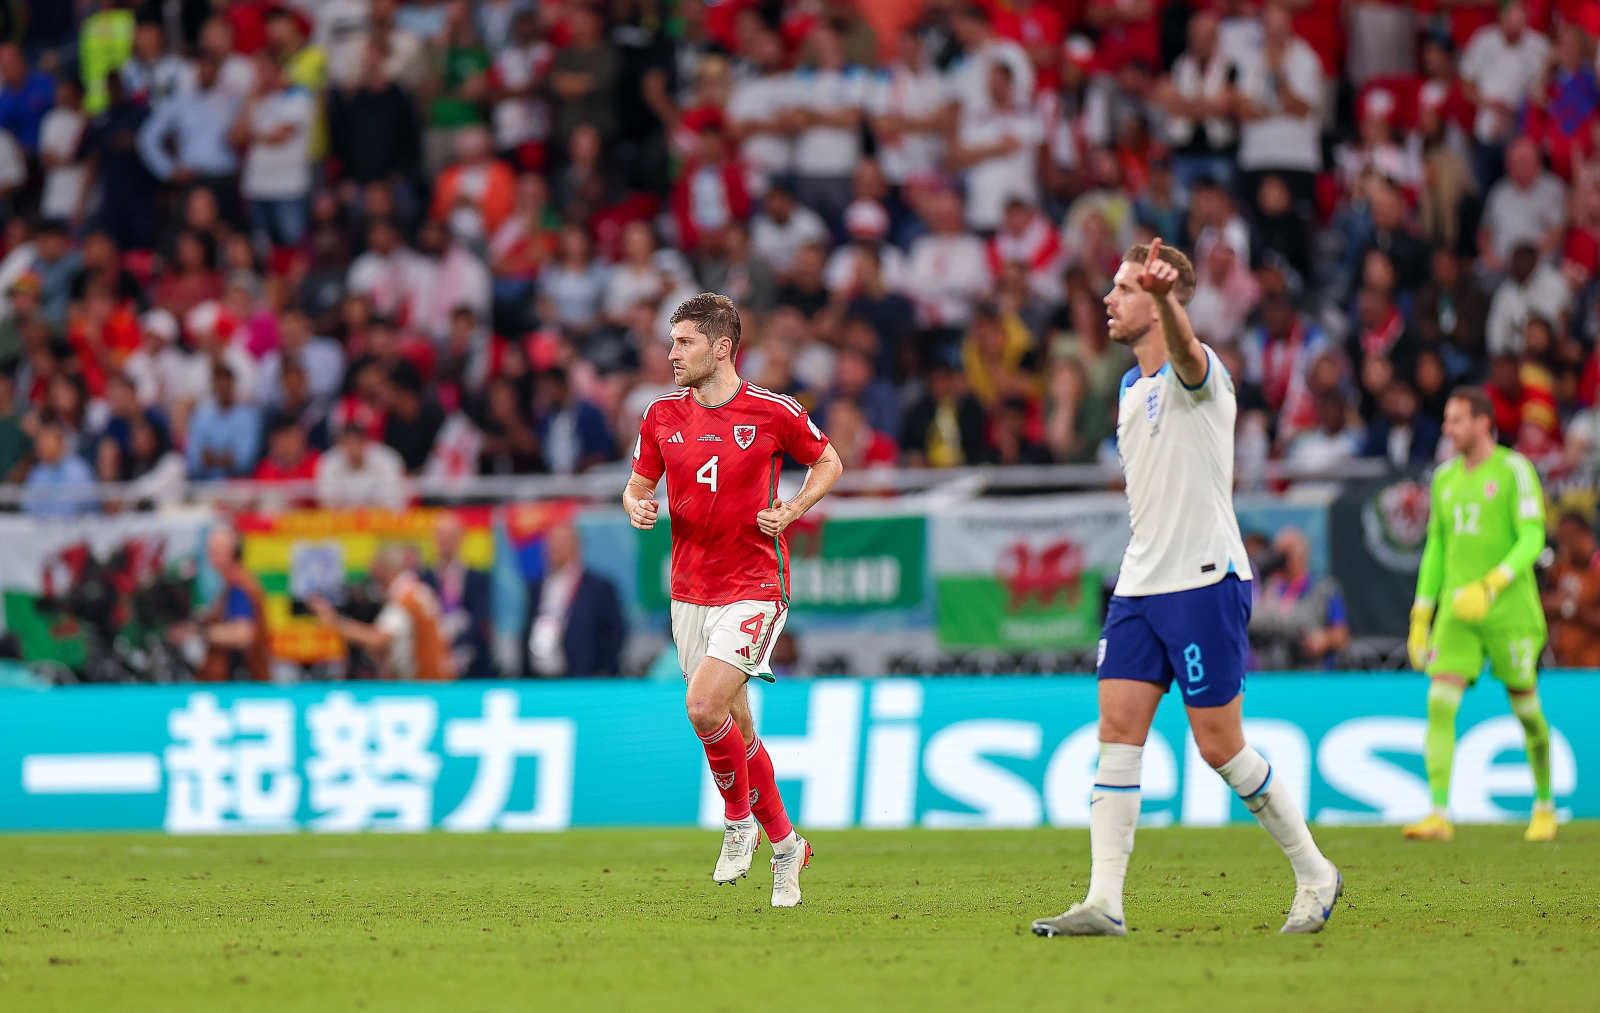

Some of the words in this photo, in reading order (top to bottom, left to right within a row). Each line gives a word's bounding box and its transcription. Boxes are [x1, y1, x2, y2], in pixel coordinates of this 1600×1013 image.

[696, 455, 719, 492] 4
[1453, 502, 1481, 535] 12
[740, 612, 766, 645] 4
[1183, 642, 1204, 683] 8
[22, 689, 576, 832] 一起努力
[697, 677, 1577, 831] Hisense
